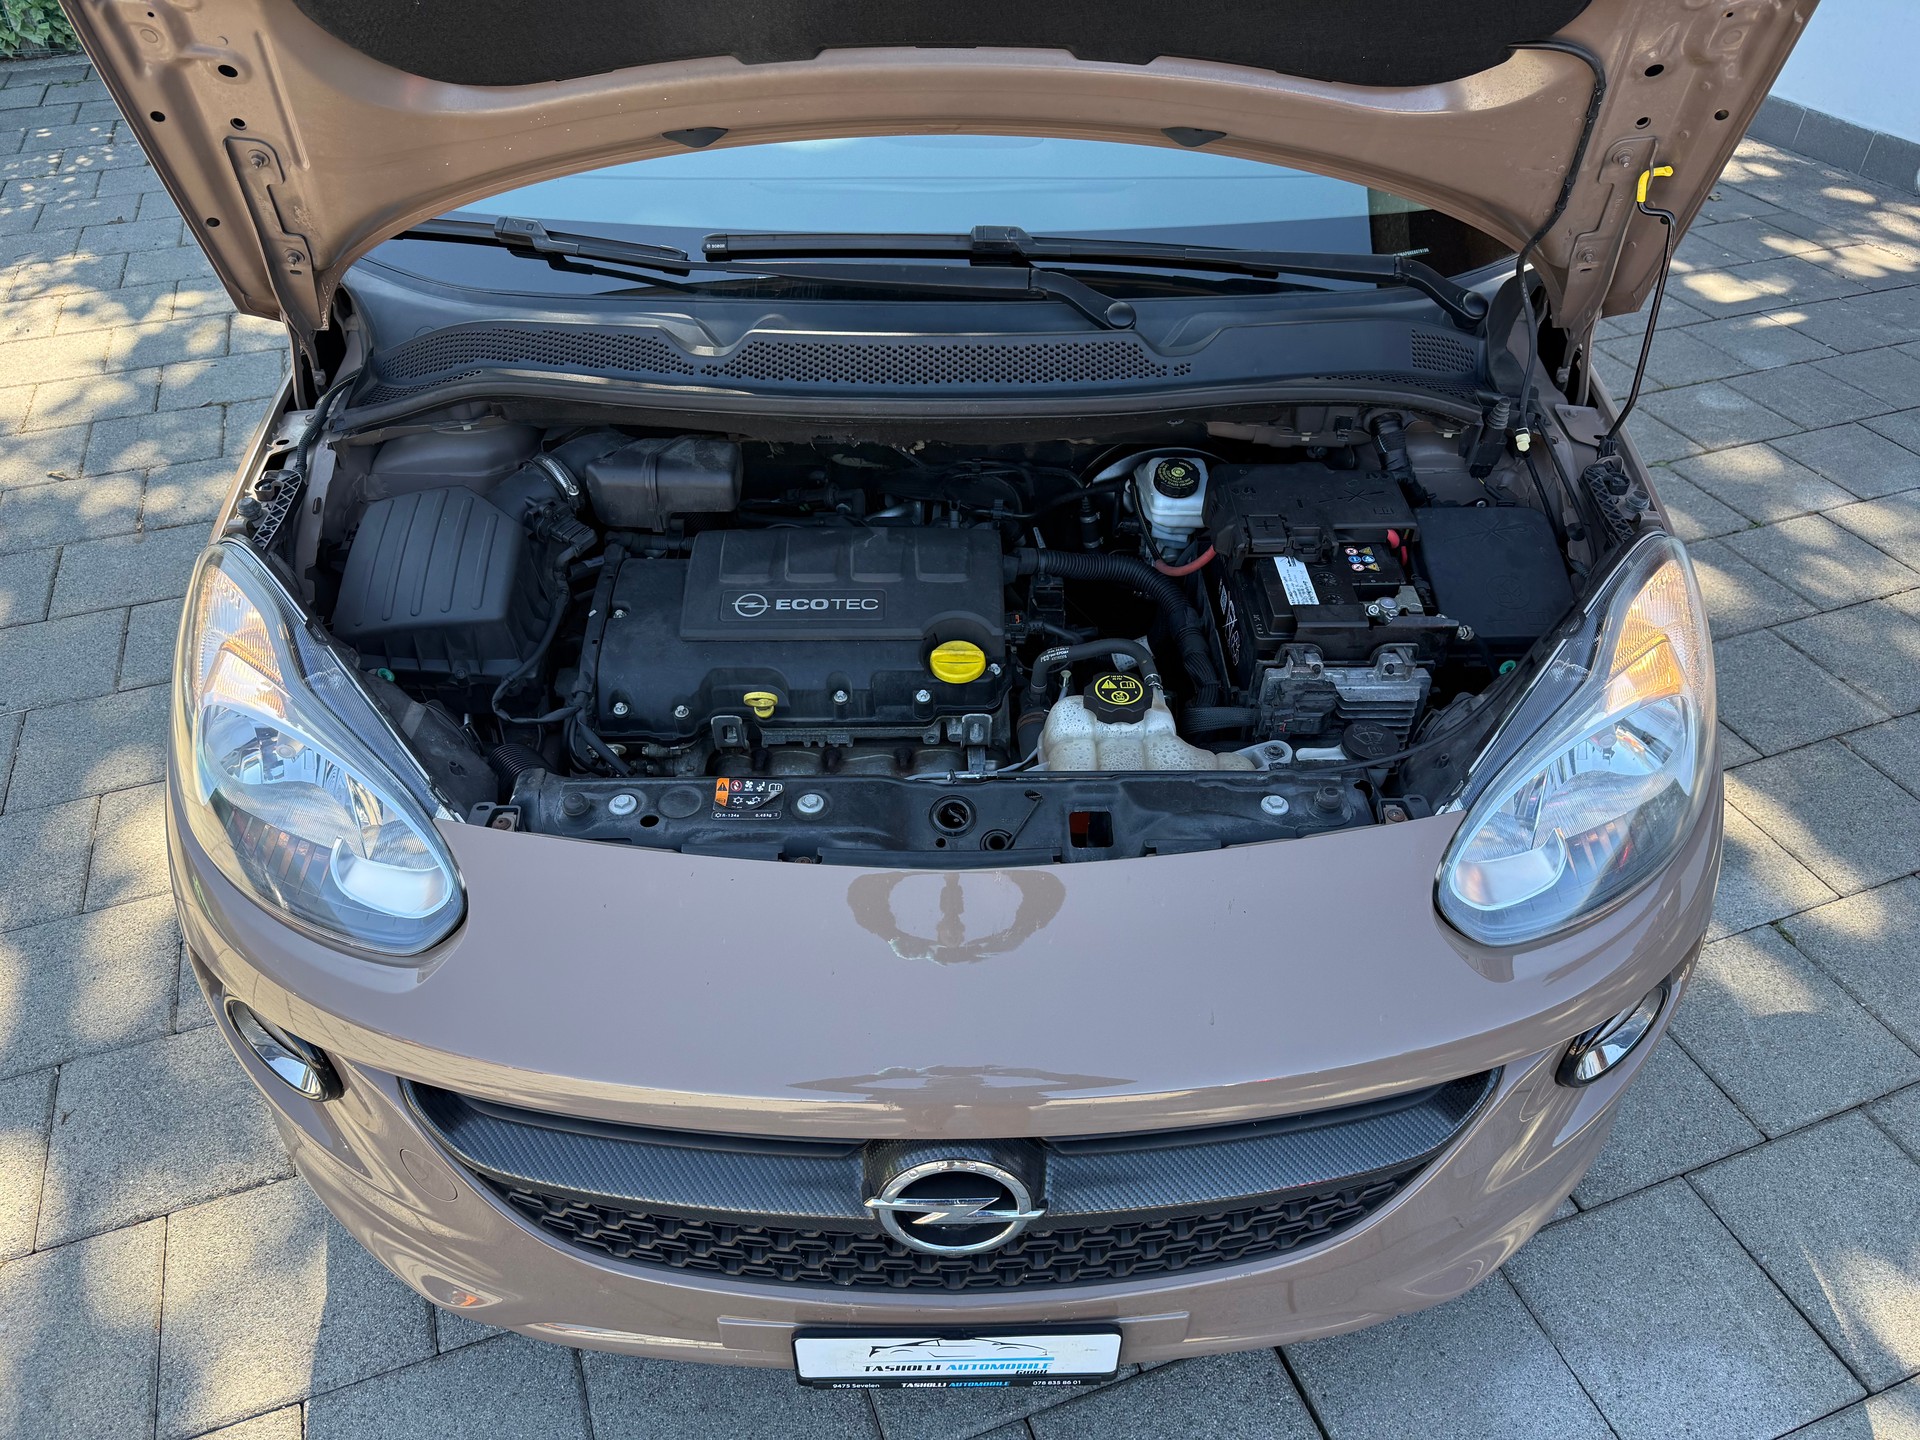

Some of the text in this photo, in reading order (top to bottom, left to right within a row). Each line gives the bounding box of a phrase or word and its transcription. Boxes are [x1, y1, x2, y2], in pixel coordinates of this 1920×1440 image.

[776, 598, 879, 610] ECOTEC
[863, 1363, 1052, 1372] TASHOLLI AUTOMOBILE
